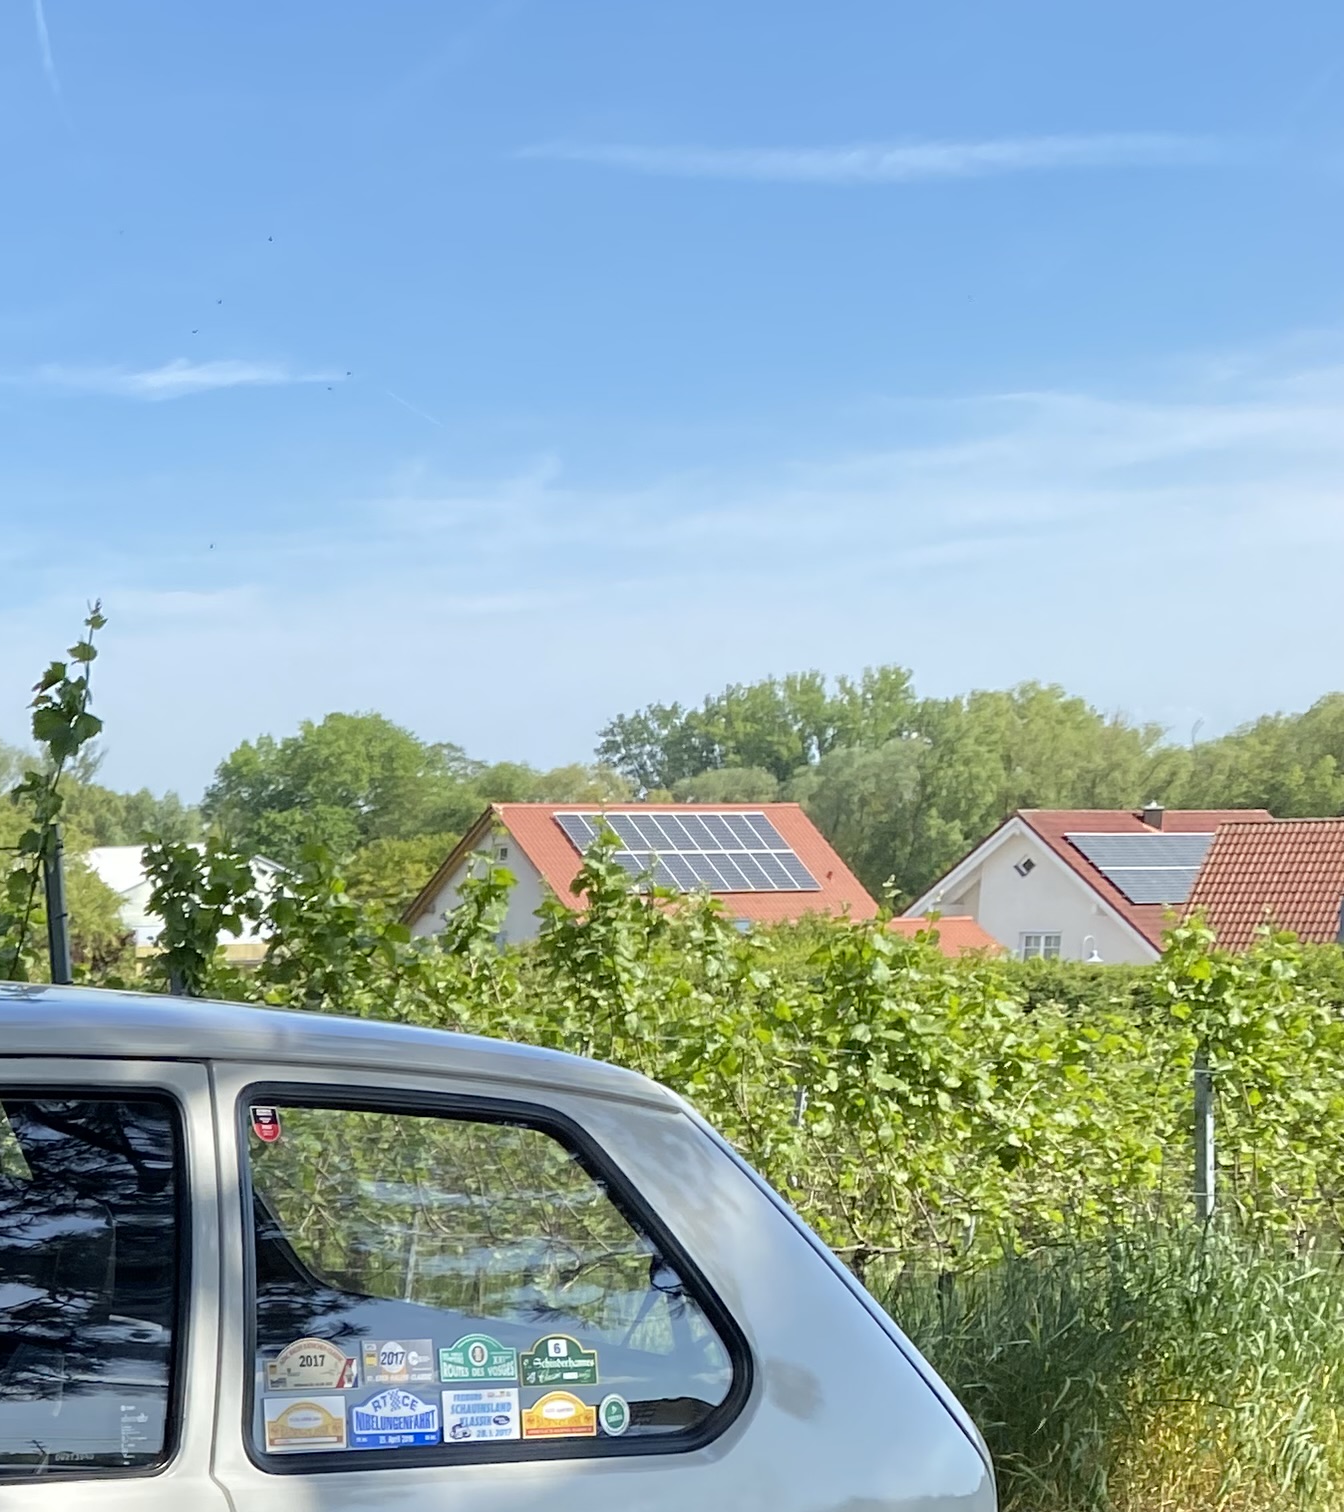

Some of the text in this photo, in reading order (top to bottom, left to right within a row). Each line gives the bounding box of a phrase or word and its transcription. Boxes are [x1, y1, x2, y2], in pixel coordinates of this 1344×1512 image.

[553, 1343, 561, 1354] 6
[299, 1354, 325, 1367] 2017
[381, 1351, 405, 1366] 2017
